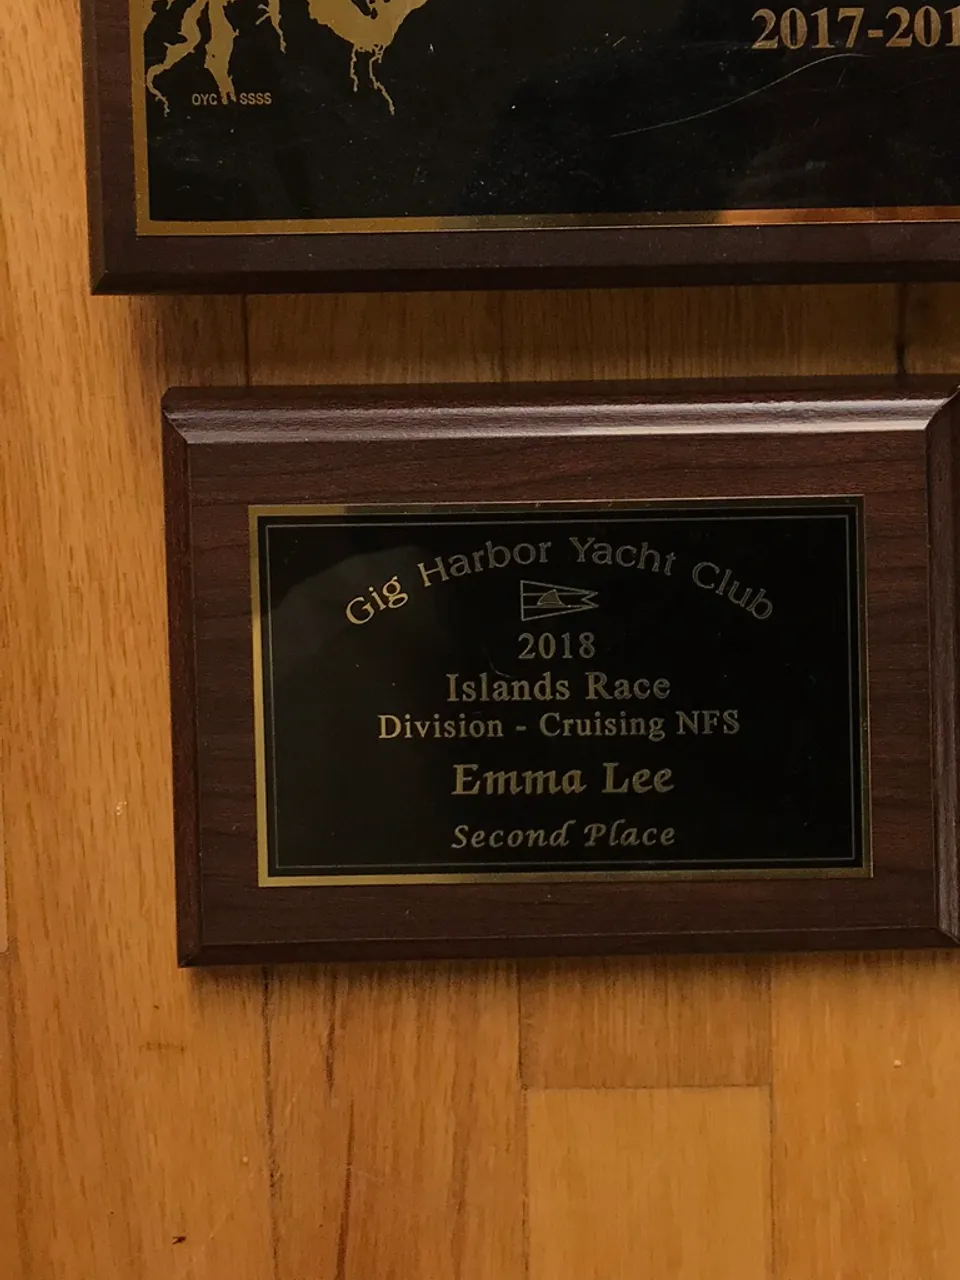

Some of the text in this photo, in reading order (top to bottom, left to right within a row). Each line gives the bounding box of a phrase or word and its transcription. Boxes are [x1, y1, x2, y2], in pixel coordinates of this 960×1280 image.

[240, 92, 272, 105] SSSS
[346, 537, 772, 624] Gig Harbor Yacht Club
[518, 632, 595, 659] 2018
[446, 671, 670, 701] Islands Race
[378, 714, 503, 738] Division
[540, 711, 665, 741] Cruising
[676, 710, 739, 734] NFS
[452, 763, 674, 794] Emma Lee
[451, 819, 674, 848] Second Place
